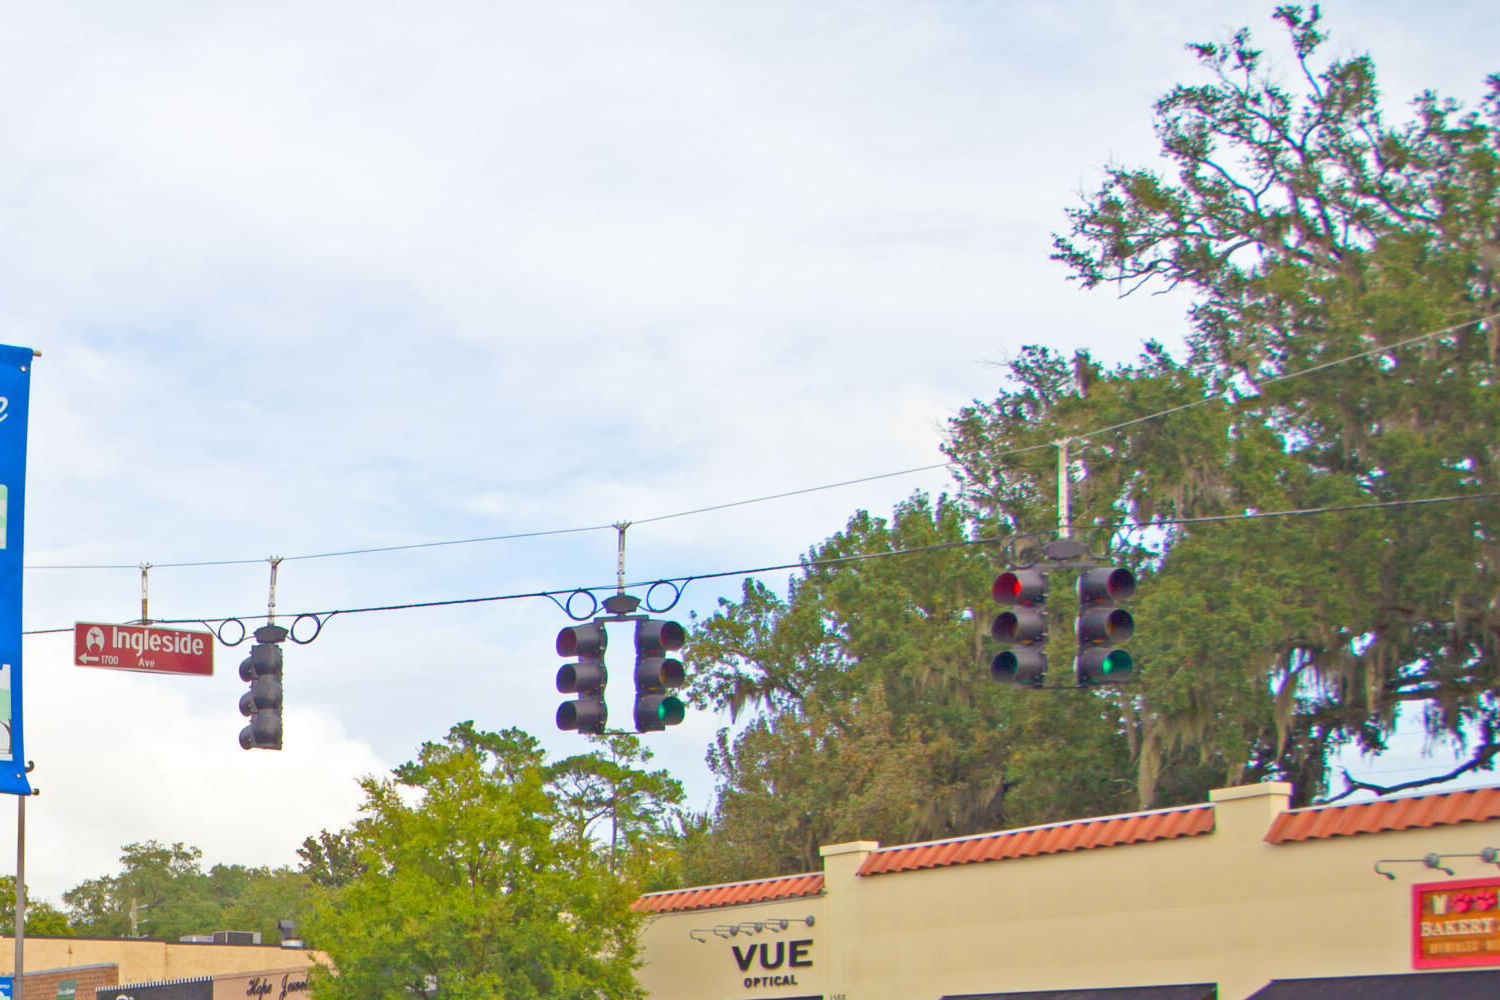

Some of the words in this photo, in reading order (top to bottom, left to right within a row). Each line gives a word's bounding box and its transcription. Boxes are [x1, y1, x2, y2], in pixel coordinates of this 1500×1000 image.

[112, 626, 204, 656] Ingleside
[102, 655, 119, 665] 1700
[138, 657, 155, 668] Ave
[1420, 917, 1493, 937] BAKERY
[731, 939, 814, 972] VUE
[743, 974, 798, 988] OPTICAL
